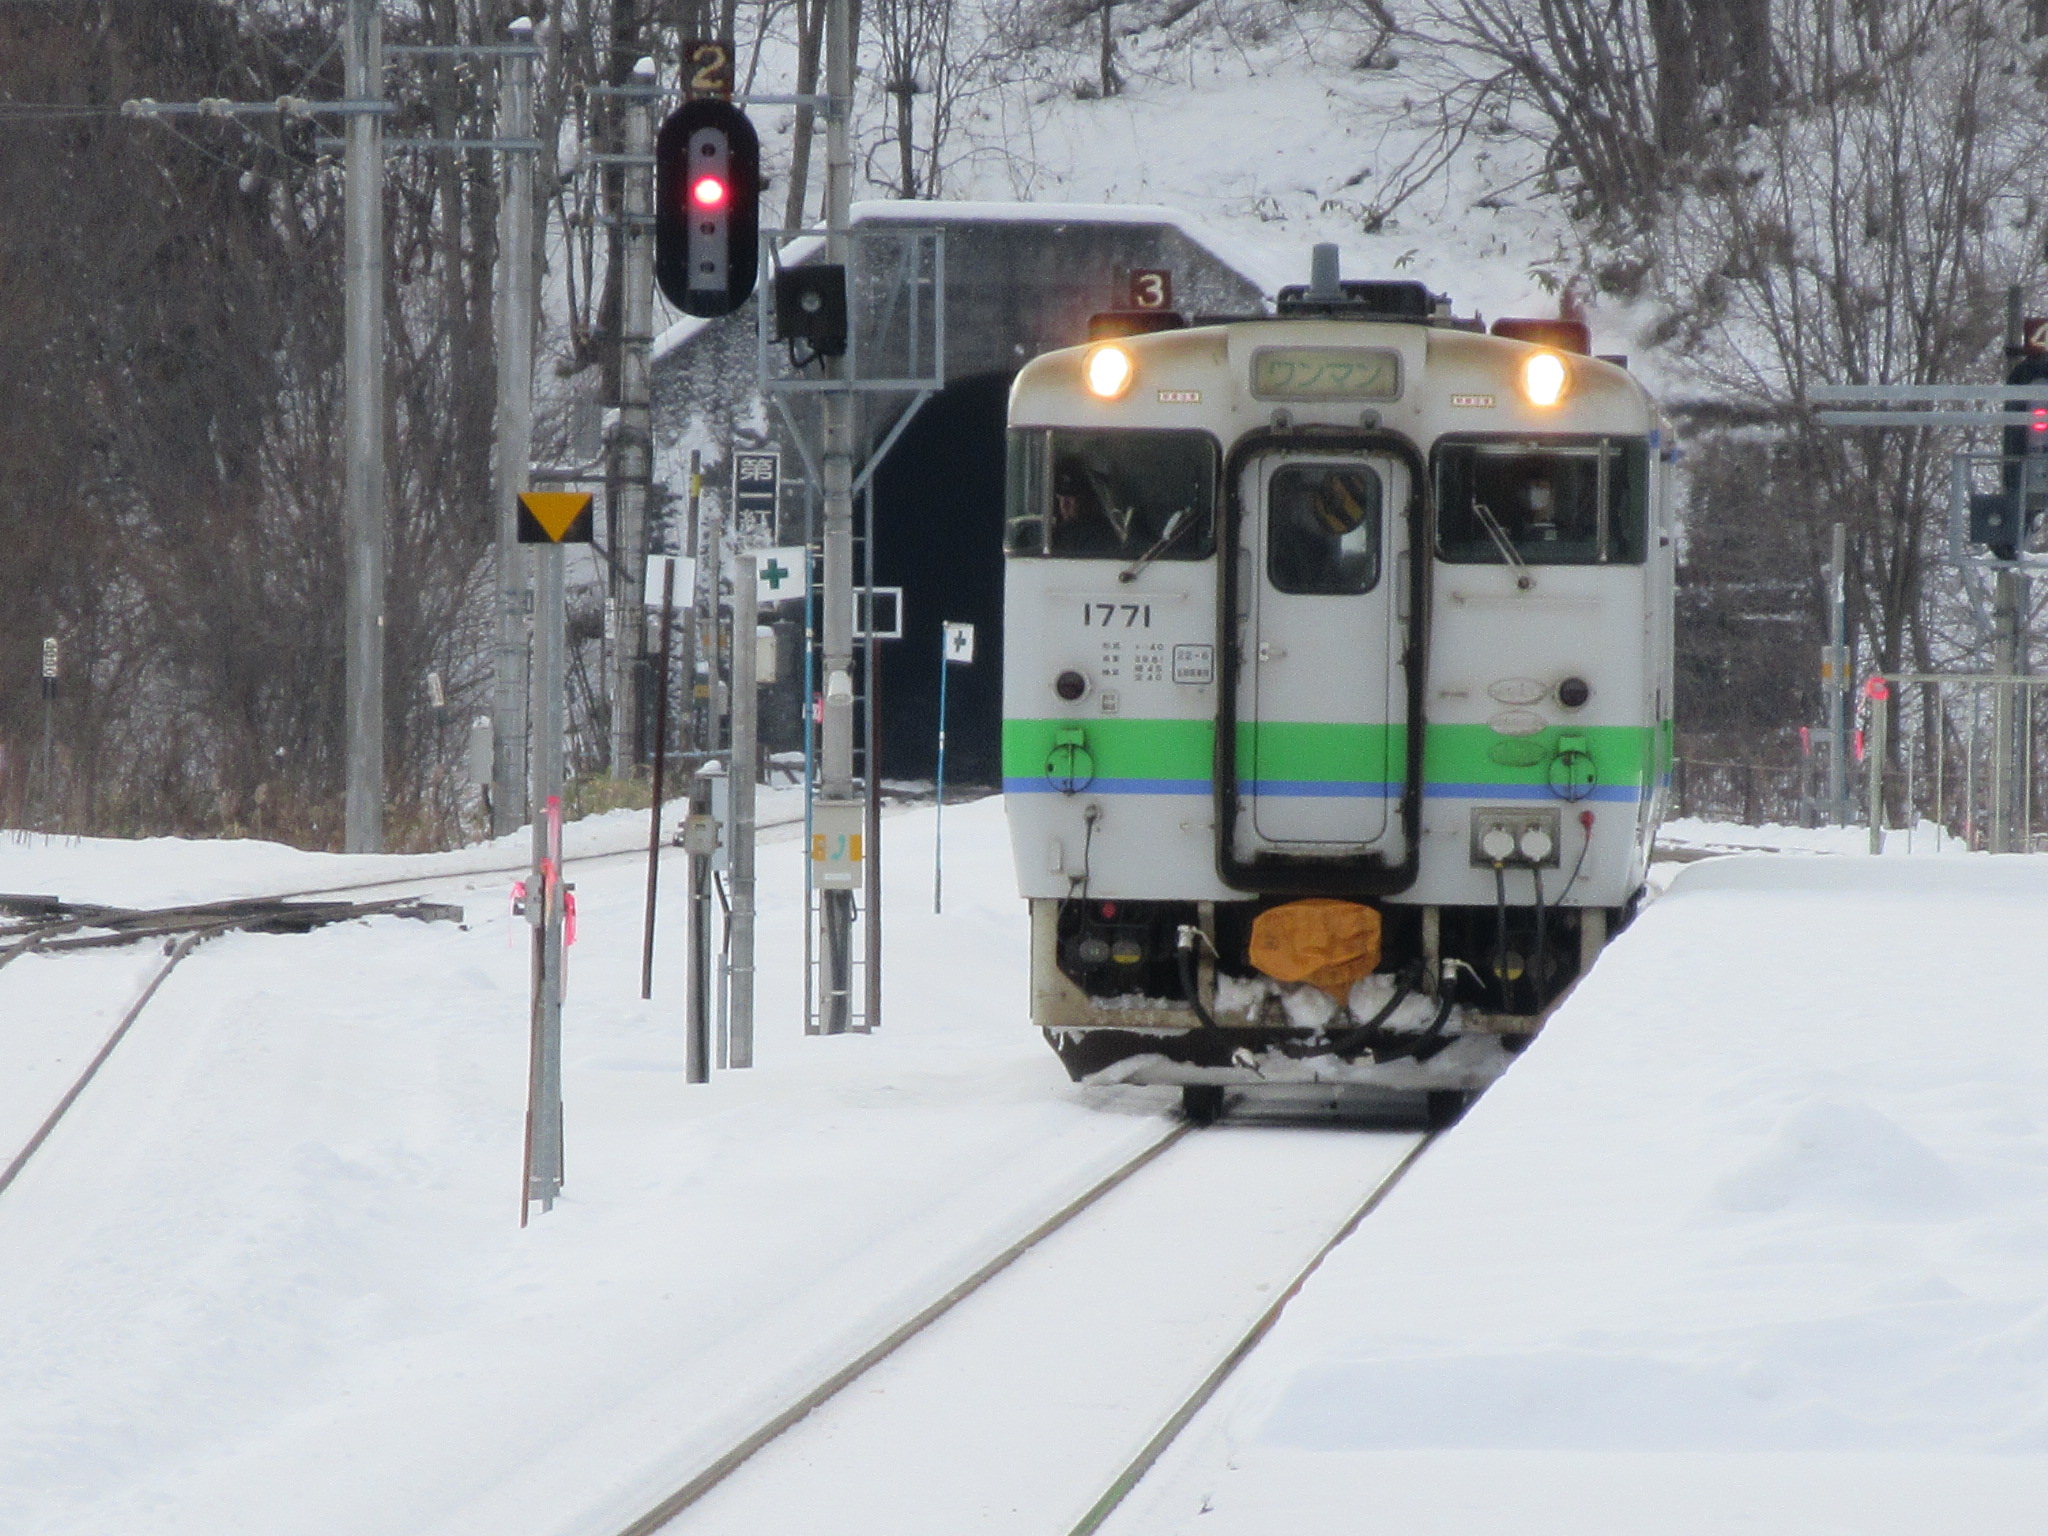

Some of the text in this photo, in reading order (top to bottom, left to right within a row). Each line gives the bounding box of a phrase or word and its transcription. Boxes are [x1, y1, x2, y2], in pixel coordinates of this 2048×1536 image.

[691, 43, 725, 87] 2
[1137, 273, 1164, 308] 3
[1269, 361, 1383, 388] ワンマン
[1084, 603, 1150, 628] 1771
